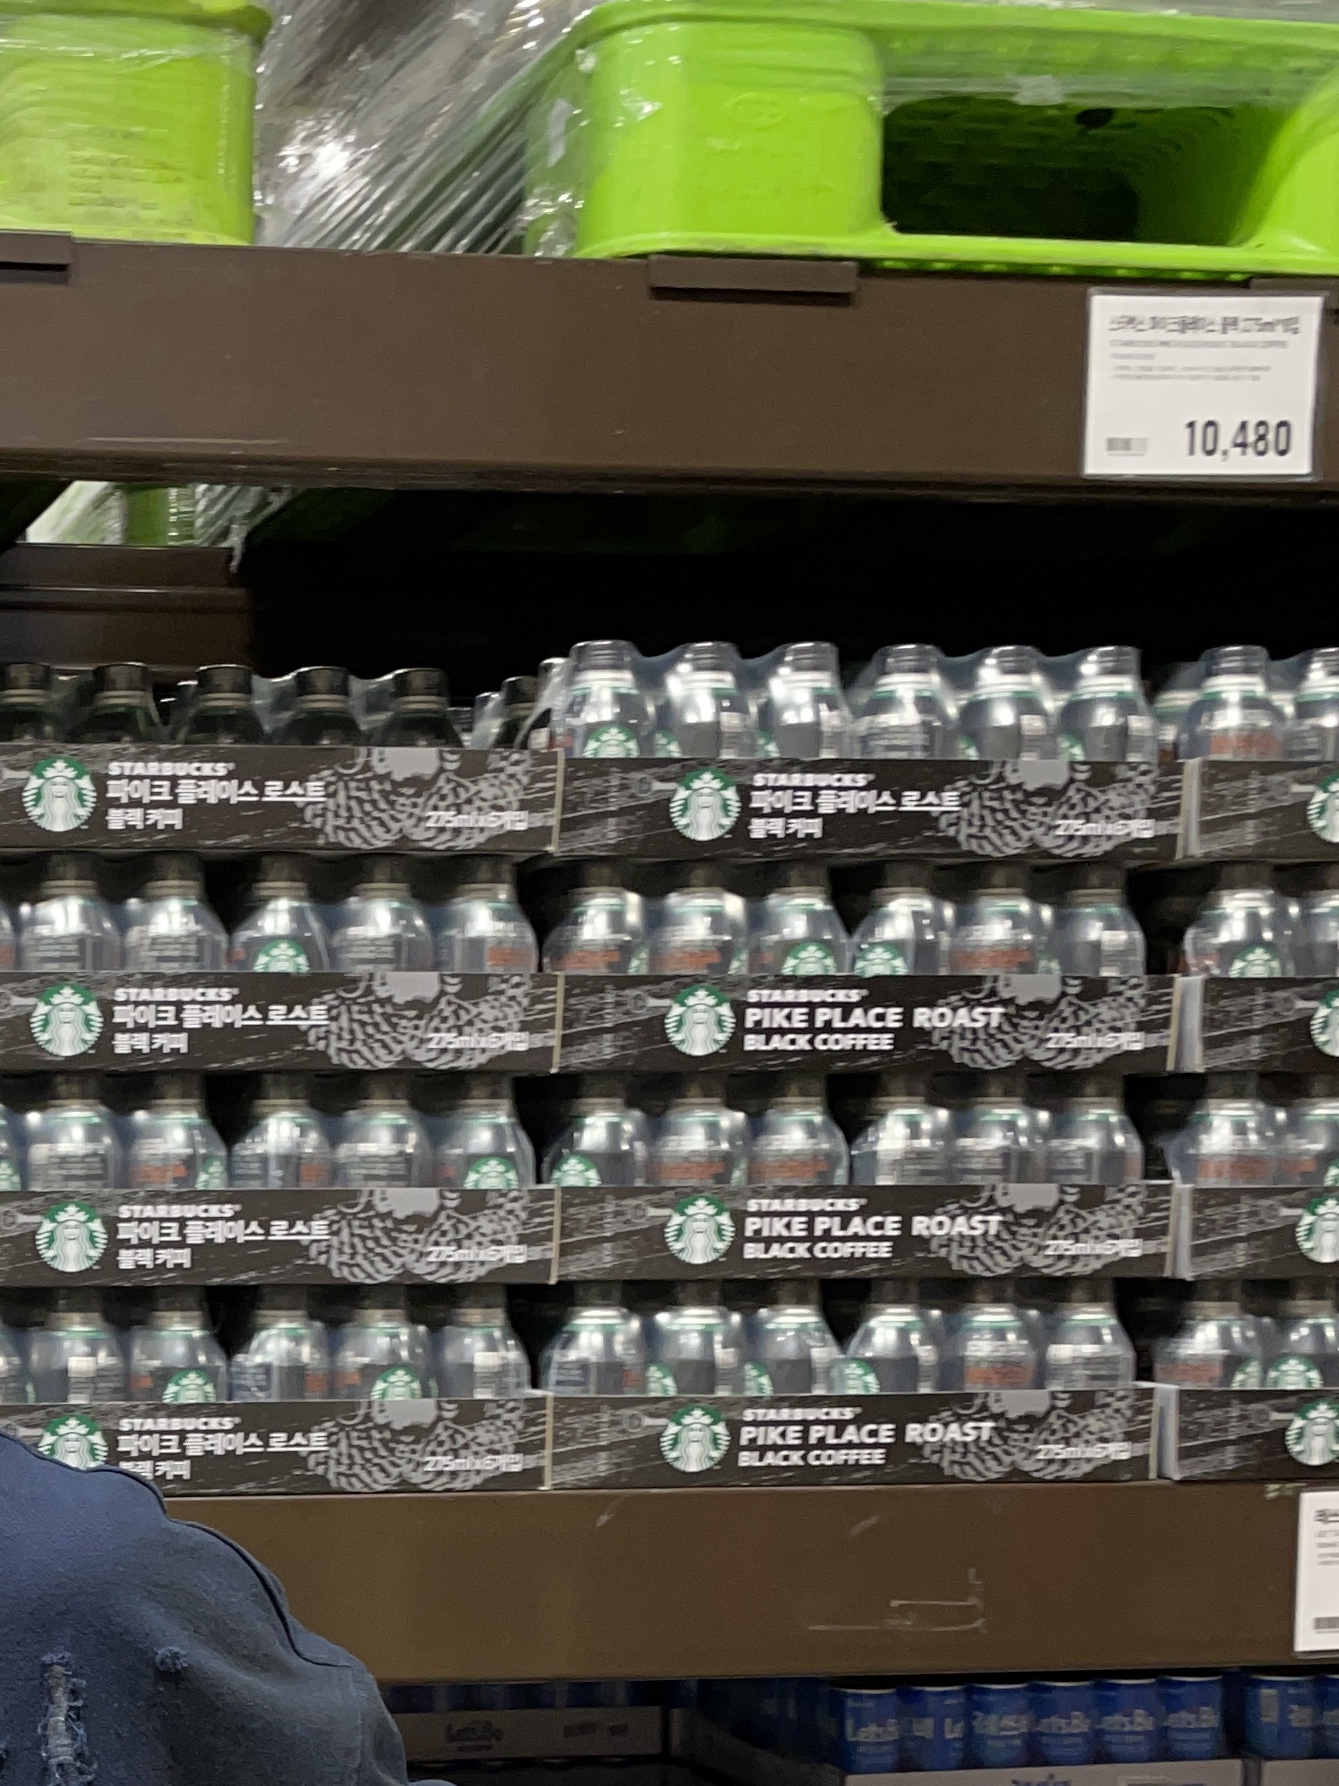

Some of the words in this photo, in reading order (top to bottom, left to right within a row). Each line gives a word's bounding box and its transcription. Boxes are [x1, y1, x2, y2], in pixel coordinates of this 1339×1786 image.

[1185, 420, 1292, 461] 10,480
[106, 779, 173, 803] 파이크
[176, 779, 260, 804] 플레이스
[261, 780, 328, 802] 로스트
[750, 790, 814, 813] 파이크
[816, 789, 896, 814] 플레이스
[898, 790, 961, 812] 로스트
[106, 808, 144, 829] 블랙
[145, 808, 183, 830] 커피
[748, 817, 785, 838] 블랙
[786, 817, 822, 838] 커피
[112, 1004, 179, 1028] 파이크
[180, 1004, 263, 1028] 플레이스
[265, 1004, 330, 1026] 로스트
[744, 1007, 810, 1029] PIKE
[814, 1007, 904, 1028] PLACE
[912, 1006, 1005, 1028] ROAST
[112, 1032, 150, 1054] 블랙
[151, 1032, 188, 1053] 커피
[743, 1034, 813, 1051] BLACK
[813, 1033, 895, 1050] COFFEE
[116, 1221, 182, 1244] 파이크
[184, 1220, 265, 1244] 플레이스
[267, 1220, 332, 1241] 로스트
[744, 1216, 808, 1237] PIKE
[814, 1215, 903, 1236] PLACE
[911, 1215, 1003, 1236] ROAST
[116, 1248, 154, 1269] 블랙
[155, 1248, 192, 1268] 커피
[743, 1242, 812, 1259] BLACK
[813, 1241, 893, 1258] COFFEE
[117, 1433, 182, 1456] 파이크
[183, 1433, 264, 1456] 플레이스
[266, 1432, 330, 1452] 로스트
[739, 1425, 804, 1446] PIKE
[809, 1423, 897, 1445] PLACE
[905, 1421, 996, 1443] ROAST
[737, 1450, 806, 1467] BLACK
[807, 1448, 887, 1466] COFFEE
[155, 1460, 191, 1480] 커피
